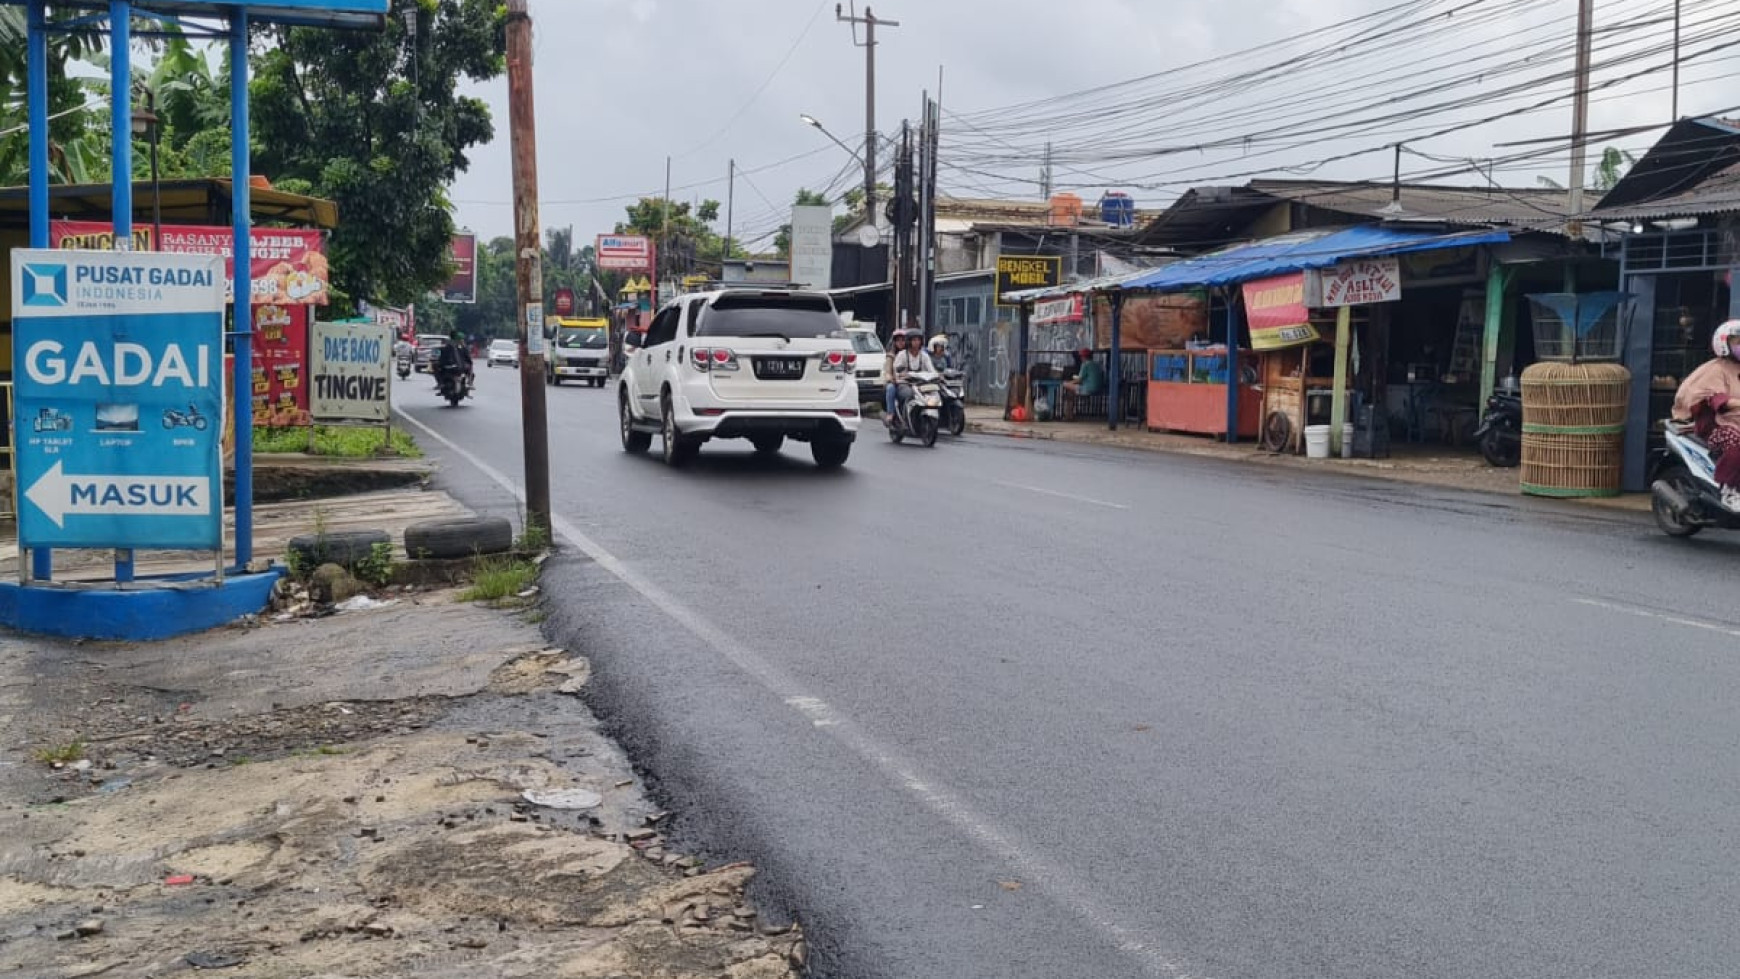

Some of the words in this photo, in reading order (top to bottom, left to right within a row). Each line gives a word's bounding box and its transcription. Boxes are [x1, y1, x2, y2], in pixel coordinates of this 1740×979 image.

[76, 265, 145, 284] PUSAT
[148, 267, 213, 286] GADAI
[1000, 260, 1050, 273] BENGKEL
[77, 286, 162, 301] INDONESIA
[350, 338, 380, 364] BAKO
[25, 340, 209, 388] GADAI
[315, 374, 386, 401] TINGWE
[70, 483, 198, 507] MASUK
